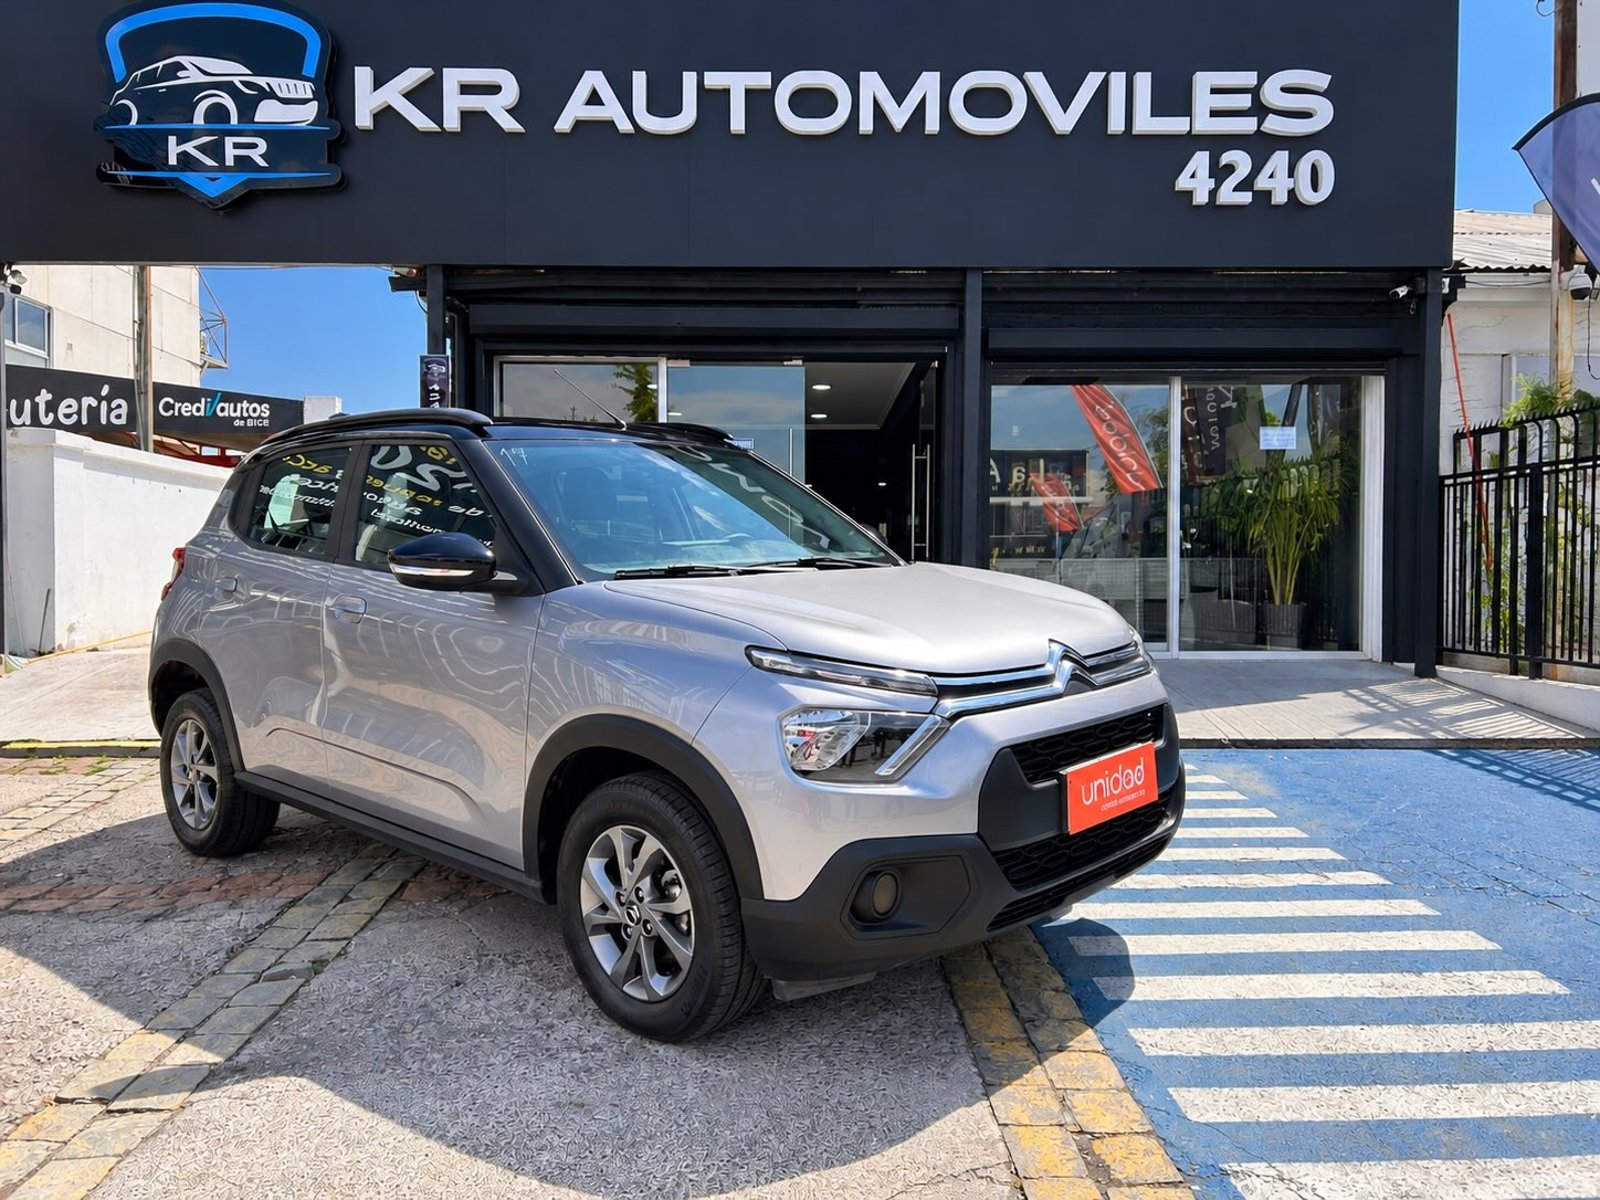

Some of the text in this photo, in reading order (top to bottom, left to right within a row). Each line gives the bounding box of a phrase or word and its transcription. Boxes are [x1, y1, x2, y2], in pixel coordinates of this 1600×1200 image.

[354, 66, 1335, 137] KR AUTOMOVILES
[168, 135, 269, 167] KR
[1174, 149, 1336, 206] 4240
[233, 418, 270, 427] de BICE
[1081, 757, 1145, 806] unidad
